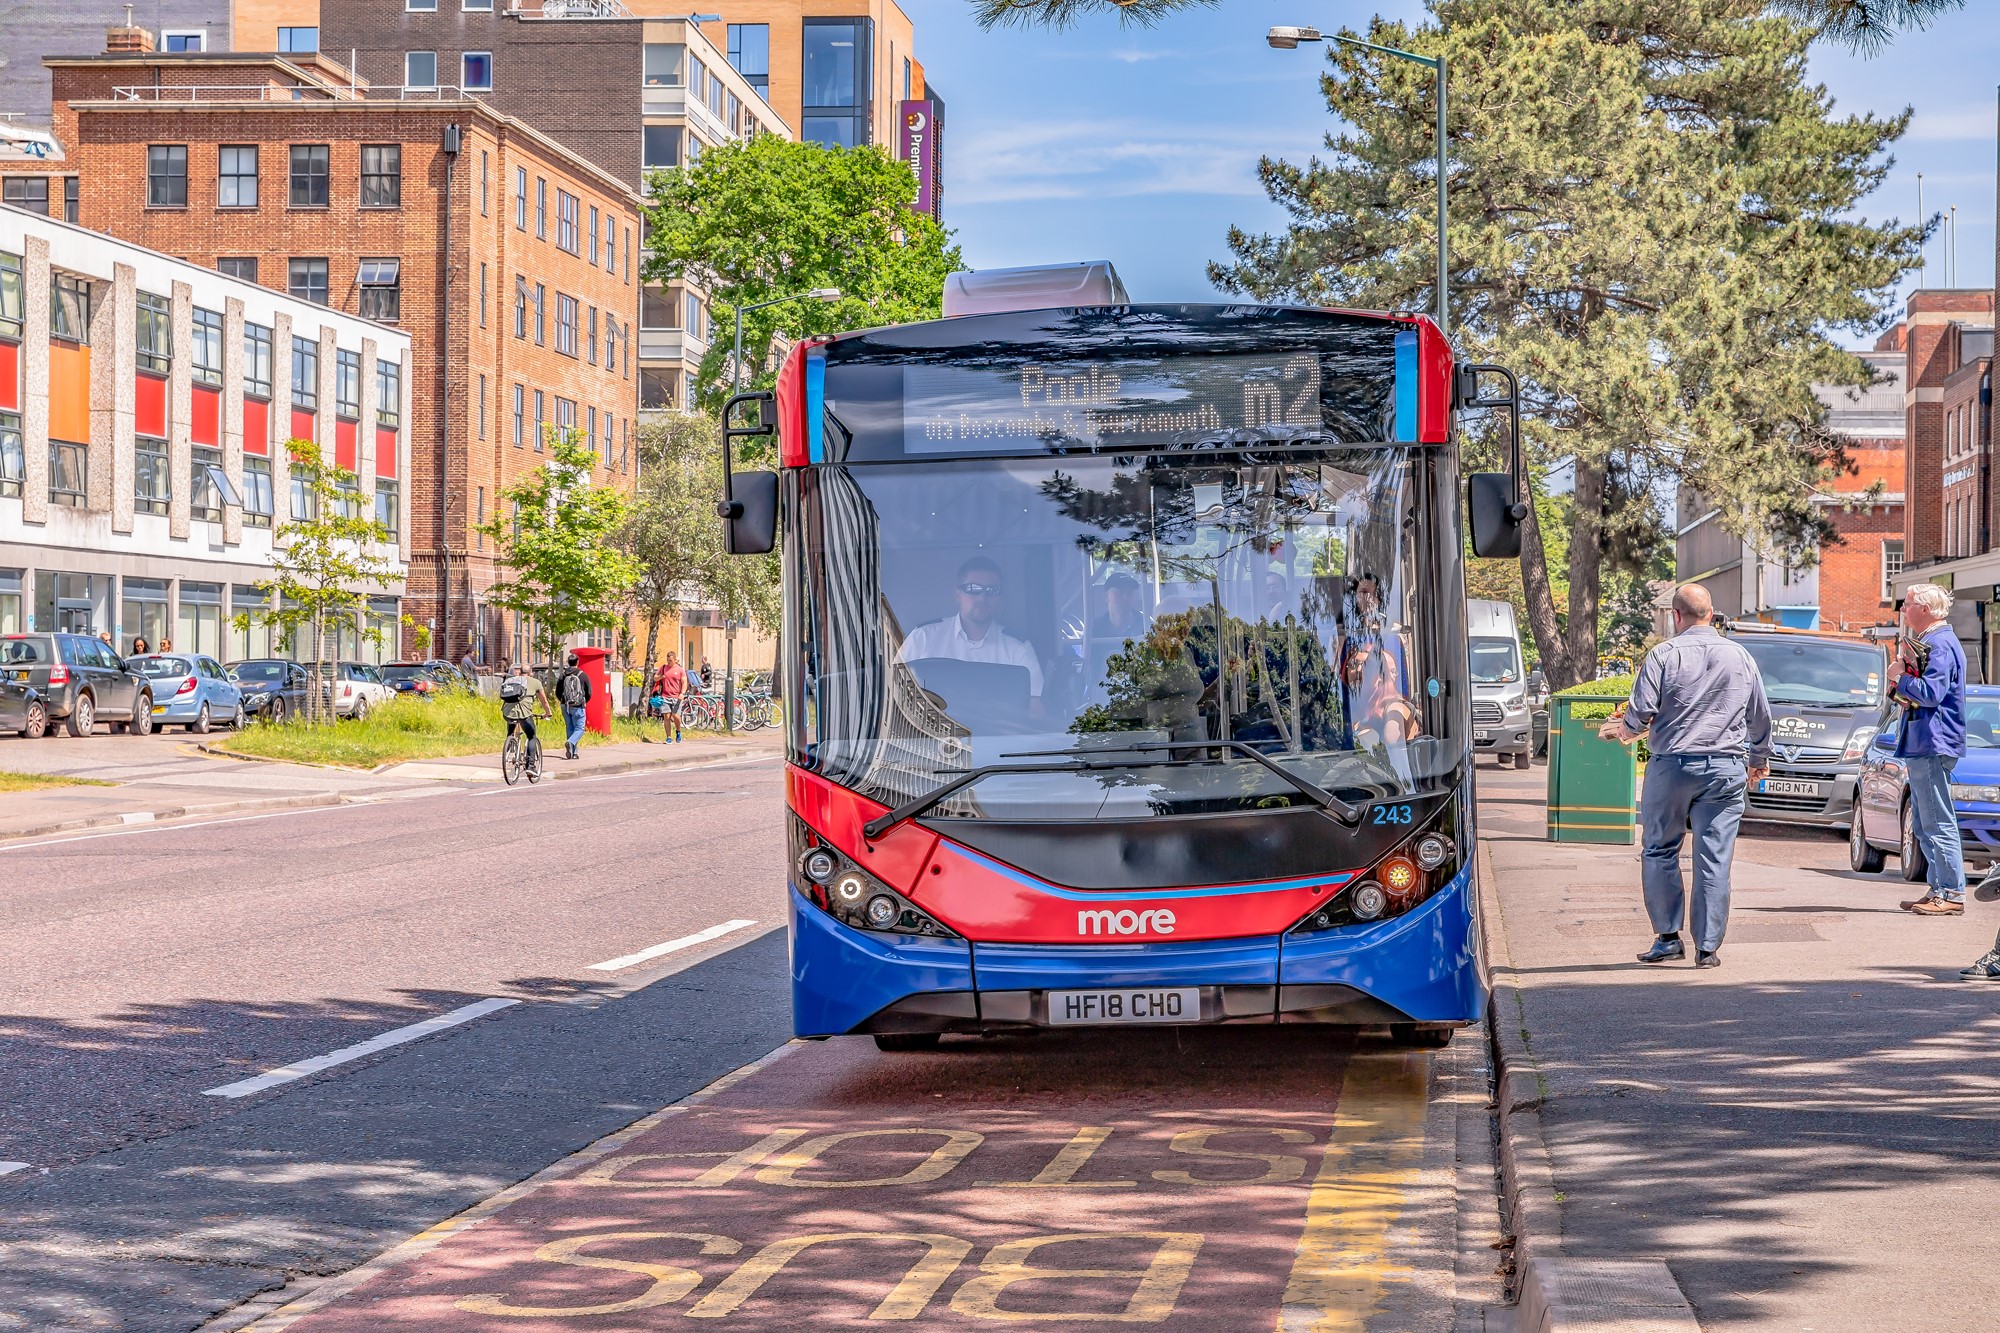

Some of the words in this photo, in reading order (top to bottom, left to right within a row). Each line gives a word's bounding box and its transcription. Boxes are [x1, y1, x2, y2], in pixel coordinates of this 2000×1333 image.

[910, 134, 923, 181] Premie
[1022, 364, 1121, 407] Poole
[1244, 356, 1322, 428] m2
[926, 414, 953, 440] via
[960, 410, 1056, 439] Boscombe
[1063, 409, 1079, 435] &
[1086, 404, 1220, 435] Bournemouth
[1771, 730, 1812, 739] electrical
[1768, 781, 1792, 792] HG13
[1794, 783, 1814, 794] NTA
[1373, 805, 1412, 825] 243
[1077, 908, 1177, 935] more
[1065, 994, 1123, 1019] HF18
[1131, 992, 1182, 1017] CHO
[576, 1127, 1316, 1188] STOP
[453, 1231, 1205, 1322] BUS
